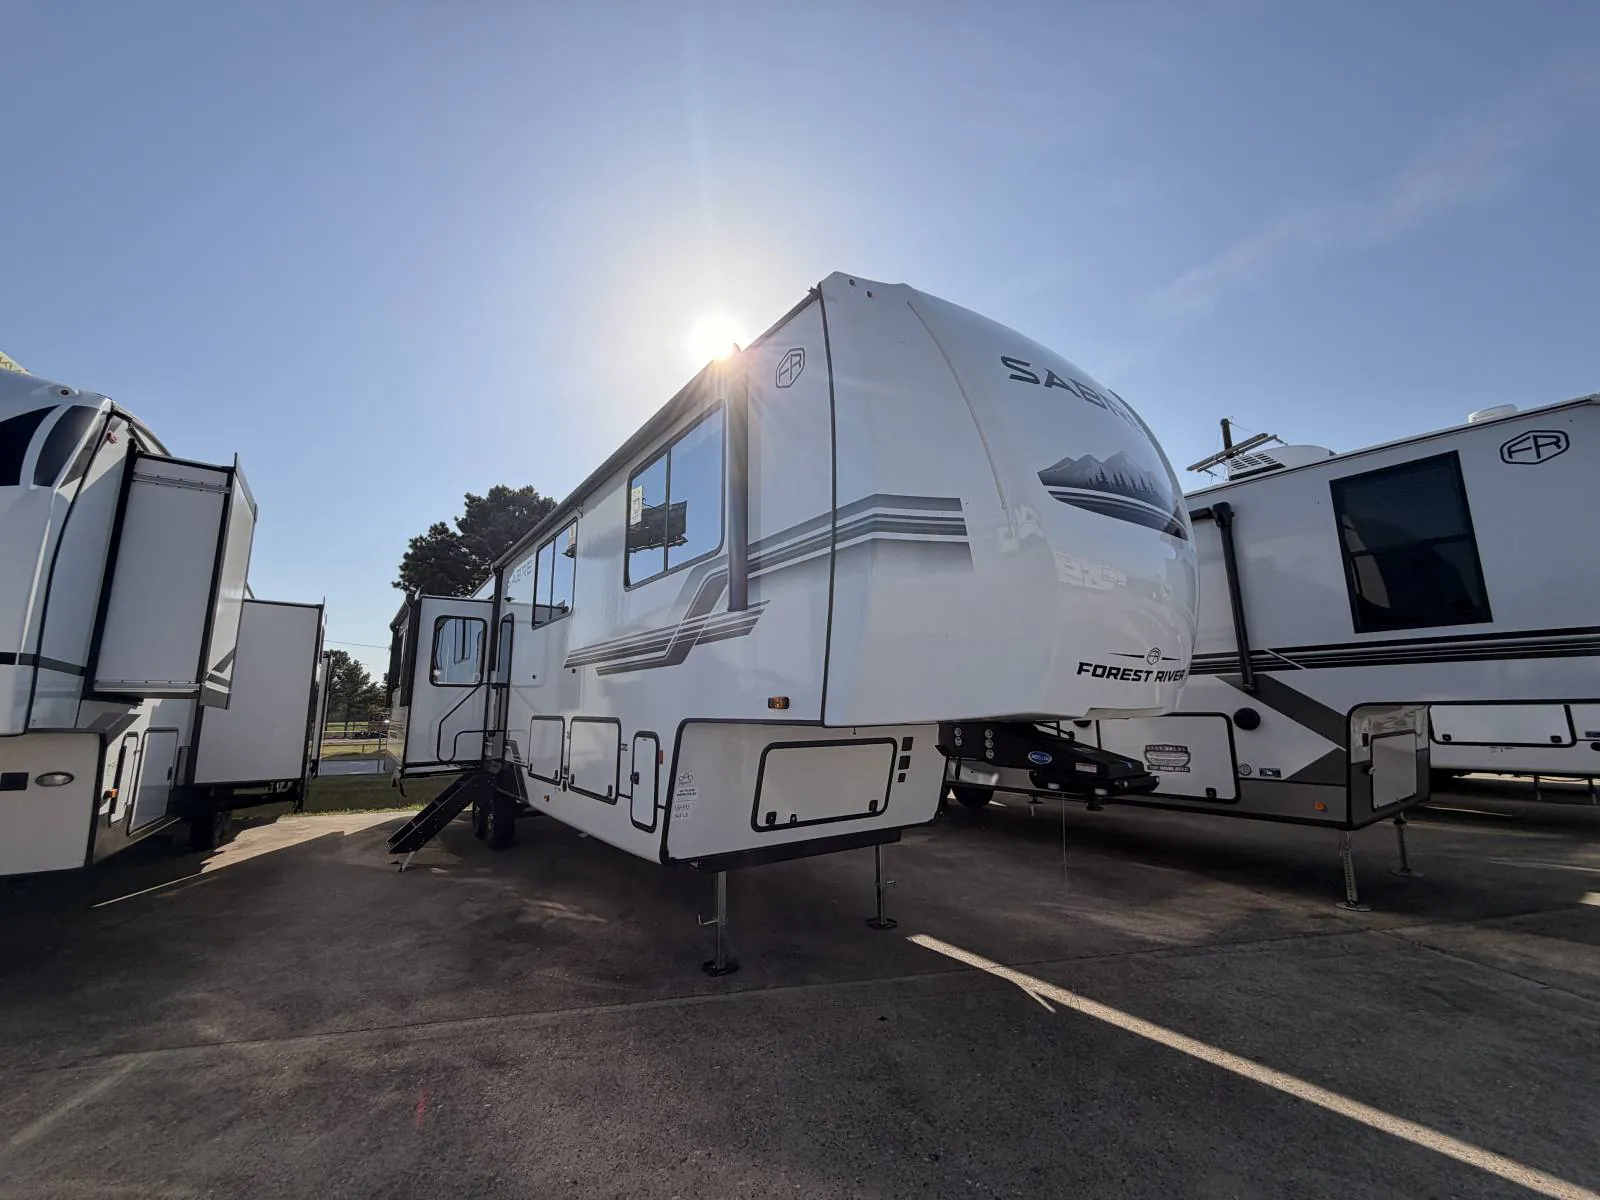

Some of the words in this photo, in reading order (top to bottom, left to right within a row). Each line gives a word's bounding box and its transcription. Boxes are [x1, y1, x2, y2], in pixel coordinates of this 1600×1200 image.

[1506, 434, 1563, 460] FR
[1077, 661, 1153, 682] FOREST
[1154, 669, 1185, 683] RIVER
